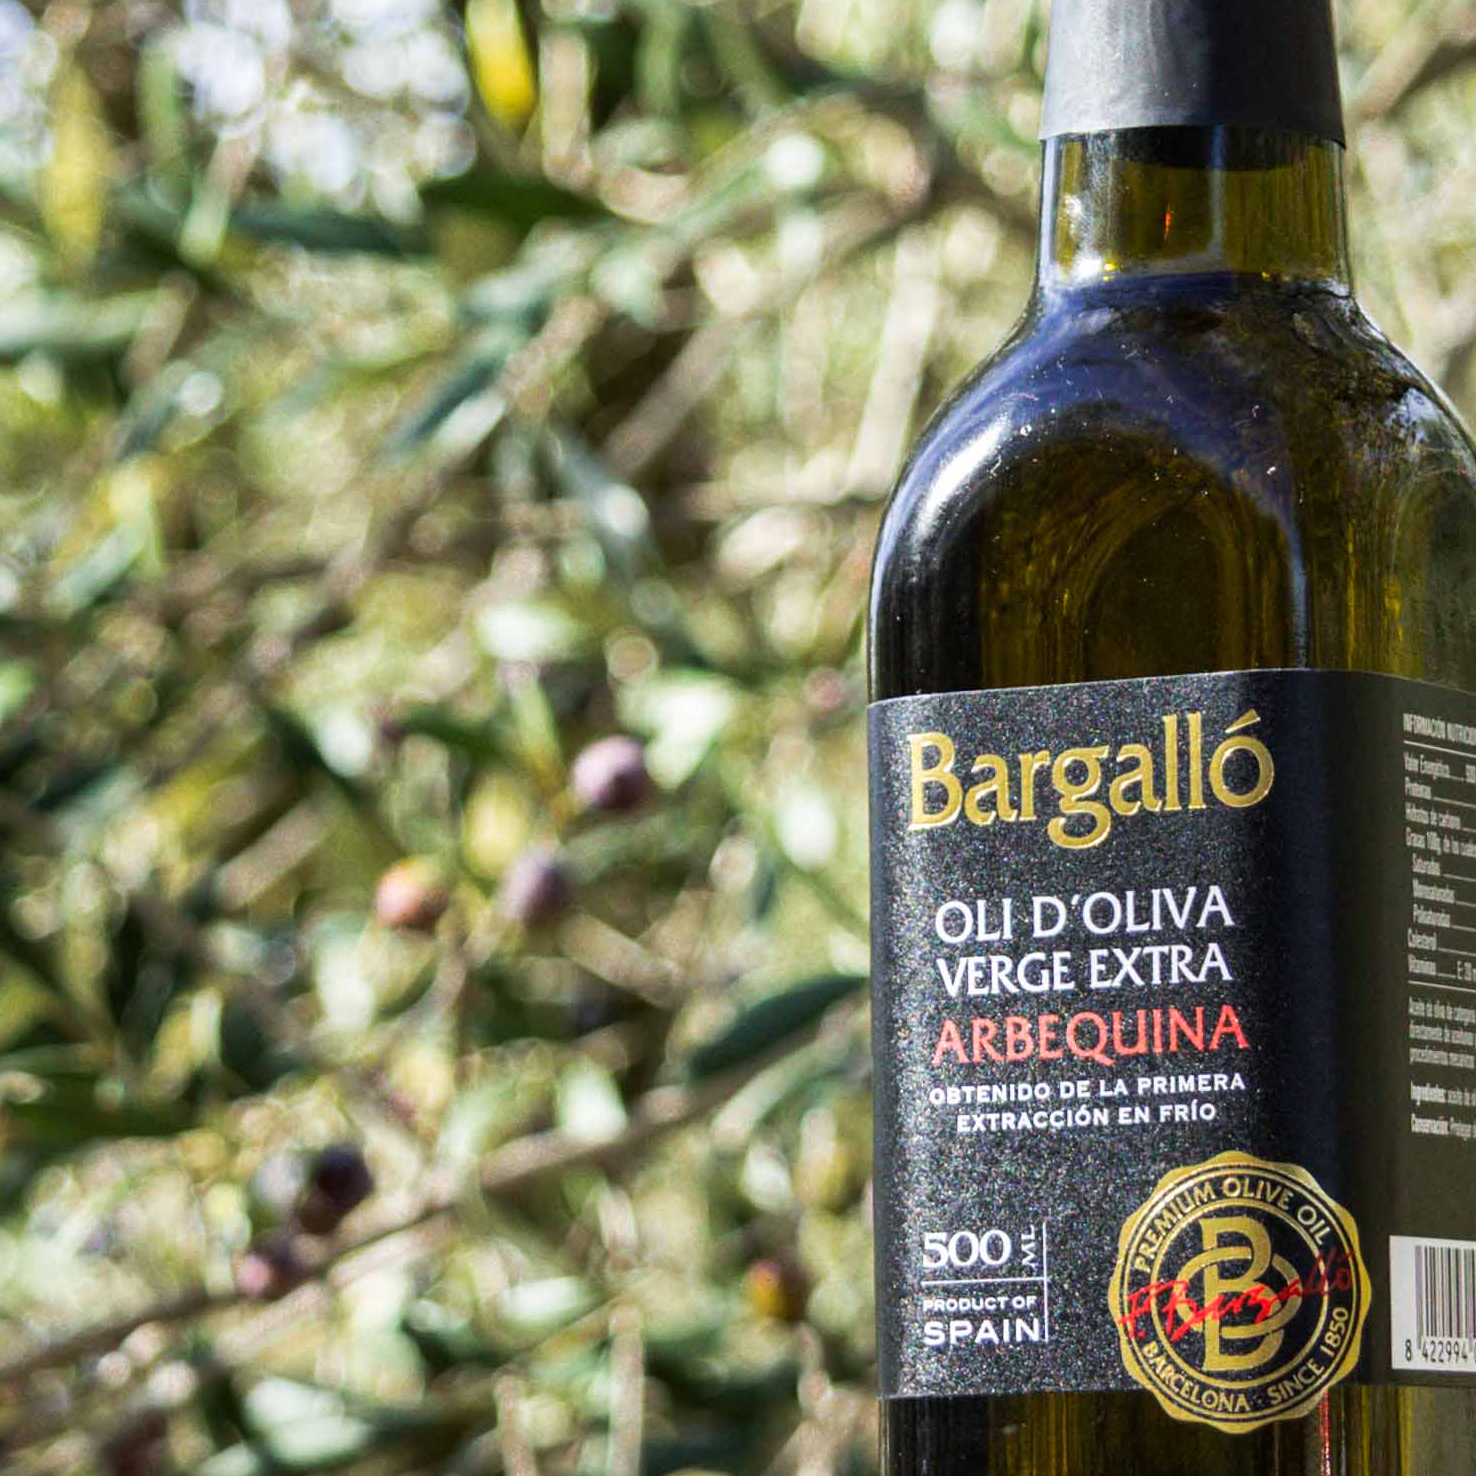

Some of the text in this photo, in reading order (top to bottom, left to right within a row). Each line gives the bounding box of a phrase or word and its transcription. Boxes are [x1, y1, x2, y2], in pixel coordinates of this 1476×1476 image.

[907, 709, 1275, 849] Bargalló
[934, 885, 1236, 944] OLI D'OLIVA
[936, 943, 1233, 997] VERGE EXTRA
[931, 1004, 1250, 1067] ARBEQUINA
[928, 1072, 1246, 1106] OBTENIDO DE LA PRIMERA
[956, 1099, 1217, 1132] EXTRACCIÓN EN FRÍO
[1134, 1176, 1332, 1273] PREMIUM OLIVE OIL
[922, 1229, 1012, 1267] 500
[923, 1294, 1037, 1312] PRODUCT OF
[923, 1318, 1040, 1346] SPAIN
[1404, 1338, 1413, 1362] 8
[1421, 1340, 1468, 1364] 422994
[1142, 1307, 1349, 1412] BARCELONA SINCE 1850
